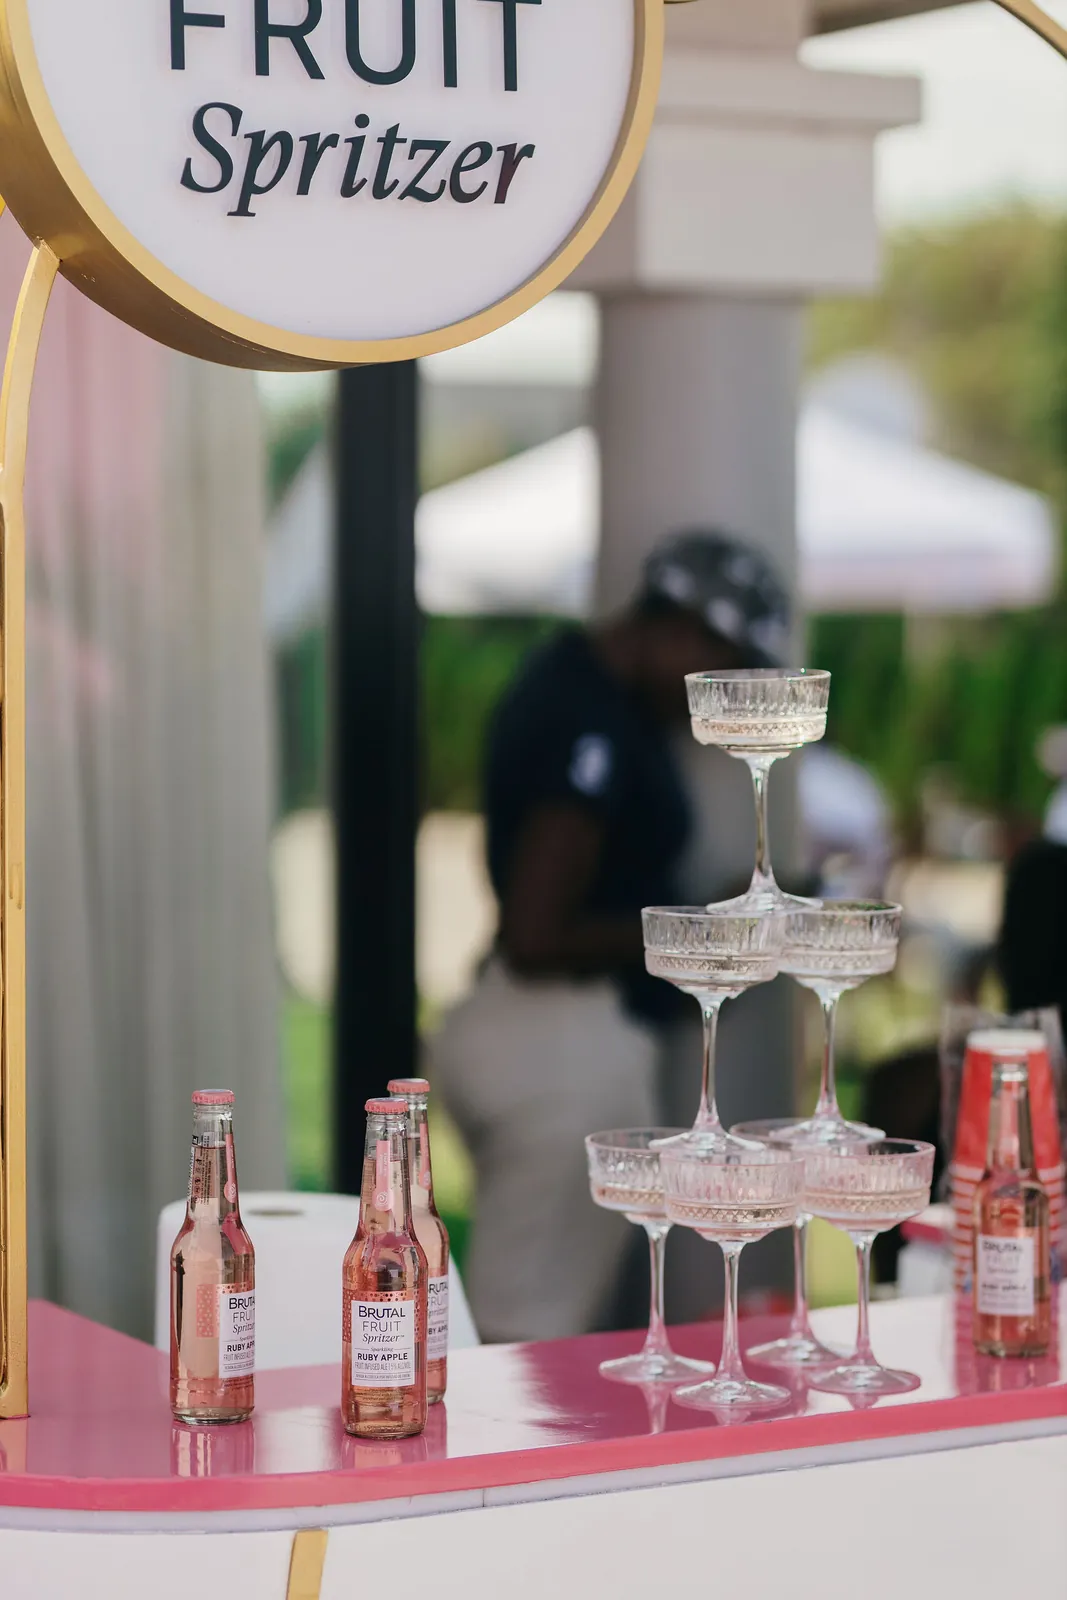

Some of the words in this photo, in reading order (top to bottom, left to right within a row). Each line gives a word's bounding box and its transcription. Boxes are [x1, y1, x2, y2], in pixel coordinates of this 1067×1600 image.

[170, 0, 543, 92] FRUIT
[180, 101, 536, 217] Spritzer
[358, 1305, 406, 1320] BRUTAL
[362, 1320, 402, 1332] FRUIT
[226, 1343, 246, 1353] RUBY
[357, 1352, 379, 1361] RUBY
[380, 1352, 408, 1361] APPLE
